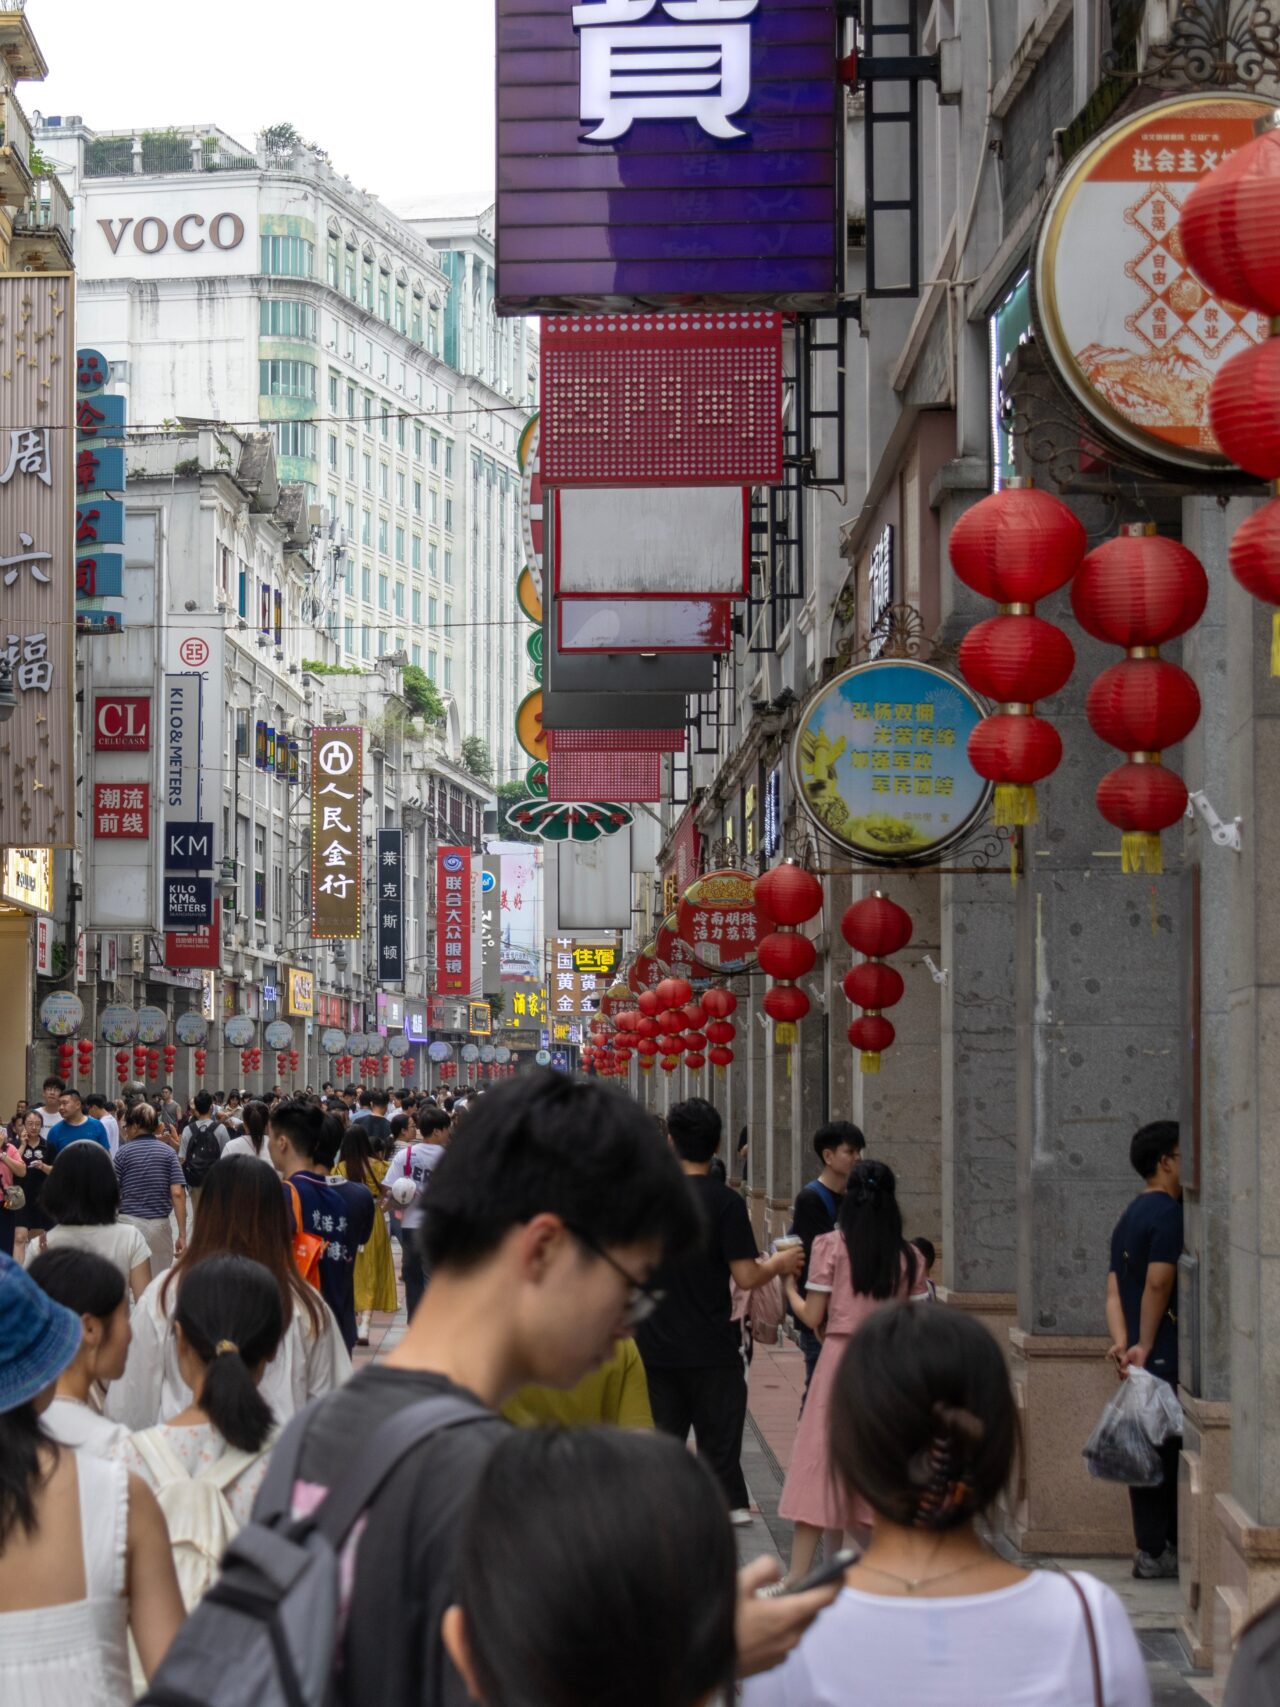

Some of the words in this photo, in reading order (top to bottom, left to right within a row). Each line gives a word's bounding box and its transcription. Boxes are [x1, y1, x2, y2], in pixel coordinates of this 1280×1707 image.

[1132, 148, 1238, 173] 社会主义
[1151, 253, 1167, 286] 自由
[1151, 307, 1167, 340] 爱国
[98, 703, 146, 737] CL
[169, 687, 184, 807] KILO&METERS
[873, 725, 956, 746] 光荣传统
[872, 775, 955, 796] 军民团结
[98, 788, 144, 809] 潮流
[98, 813, 144, 833] 前线
[170, 835, 208, 857] KM
[319, 782, 355, 899] 人民金行
[169, 884, 196, 894] KILO
[169, 903, 207, 913] METERS
[382, 850, 398, 961] 莱克斯顿
[445, 876, 463, 974] 联合大众眼镜
[572, 948, 615, 966] 住宿
